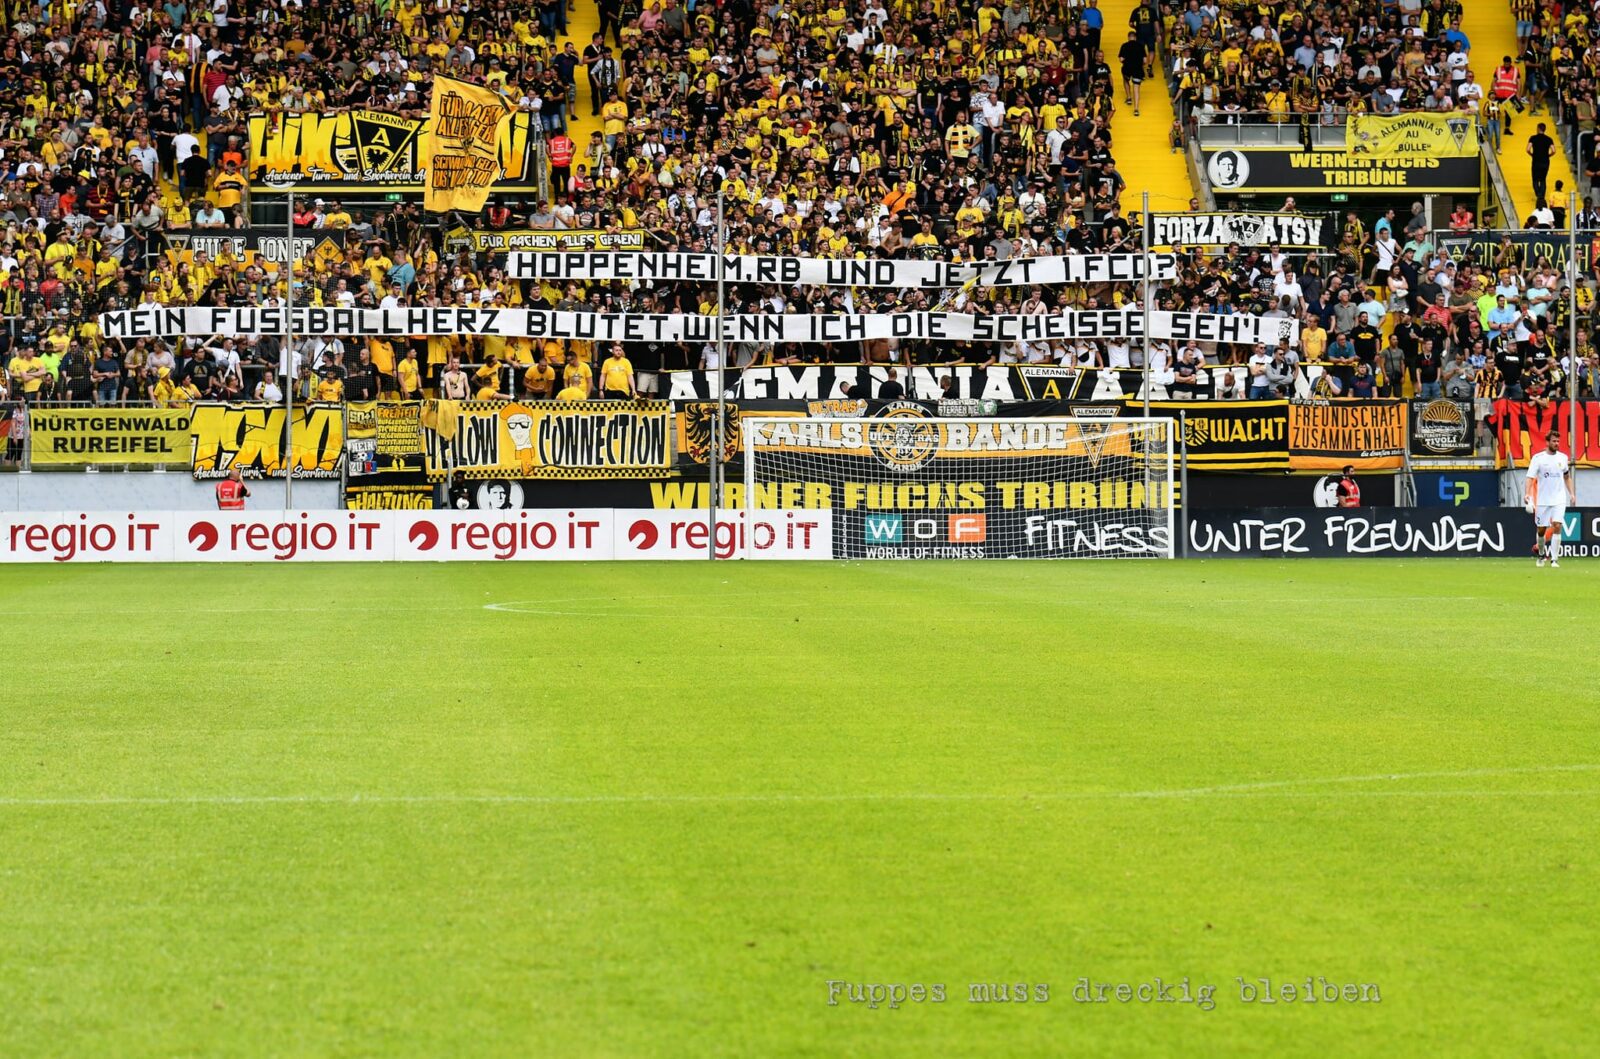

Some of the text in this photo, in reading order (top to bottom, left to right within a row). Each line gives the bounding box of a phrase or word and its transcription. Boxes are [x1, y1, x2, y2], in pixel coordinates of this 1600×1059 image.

[356, 111, 414, 130] ALEMANNIA
[1289, 153, 1371, 168] WERNER
[264, 168, 305, 181] Aachener
[343, 170, 359, 181] und
[1322, 168, 1407, 185] TRIBÜNE
[480, 234, 505, 248] FÜR
[508, 235, 556, 248] AACHEN
[1153, 216, 1223, 245] FORZA
[192, 237, 246, 263] HUE
[827, 260, 895, 285] UND
[921, 259, 1037, 286] JETZT
[104, 308, 187, 337] MEIN
[211, 308, 501, 334] FUSSBALLHERZ
[811, 314, 866, 340] ICH
[892, 312, 947, 338] DIE
[973, 310, 1144, 340] SCHEISSE
[33, 415, 190, 432] HÜRTGENWALD
[1295, 404, 1402, 429] FREUNDSCHAFT
[538, 413, 667, 466] CONNECTION
[945, 421, 1068, 451] BANDE
[1209, 417, 1287, 443] WACHT
[1293, 426, 1403, 450] ZUSAMMENHALT
[53, 437, 173, 453] RUREIFEL
[649, 477, 1182, 510] WERNER FUCHS TRIBÜNE
[10, 513, 117, 561] regio
[230, 512, 338, 560] regio
[450, 511, 557, 559] regio
[670, 511, 776, 559] regio
[866, 546, 985, 559] WORLD OF FITNESS
